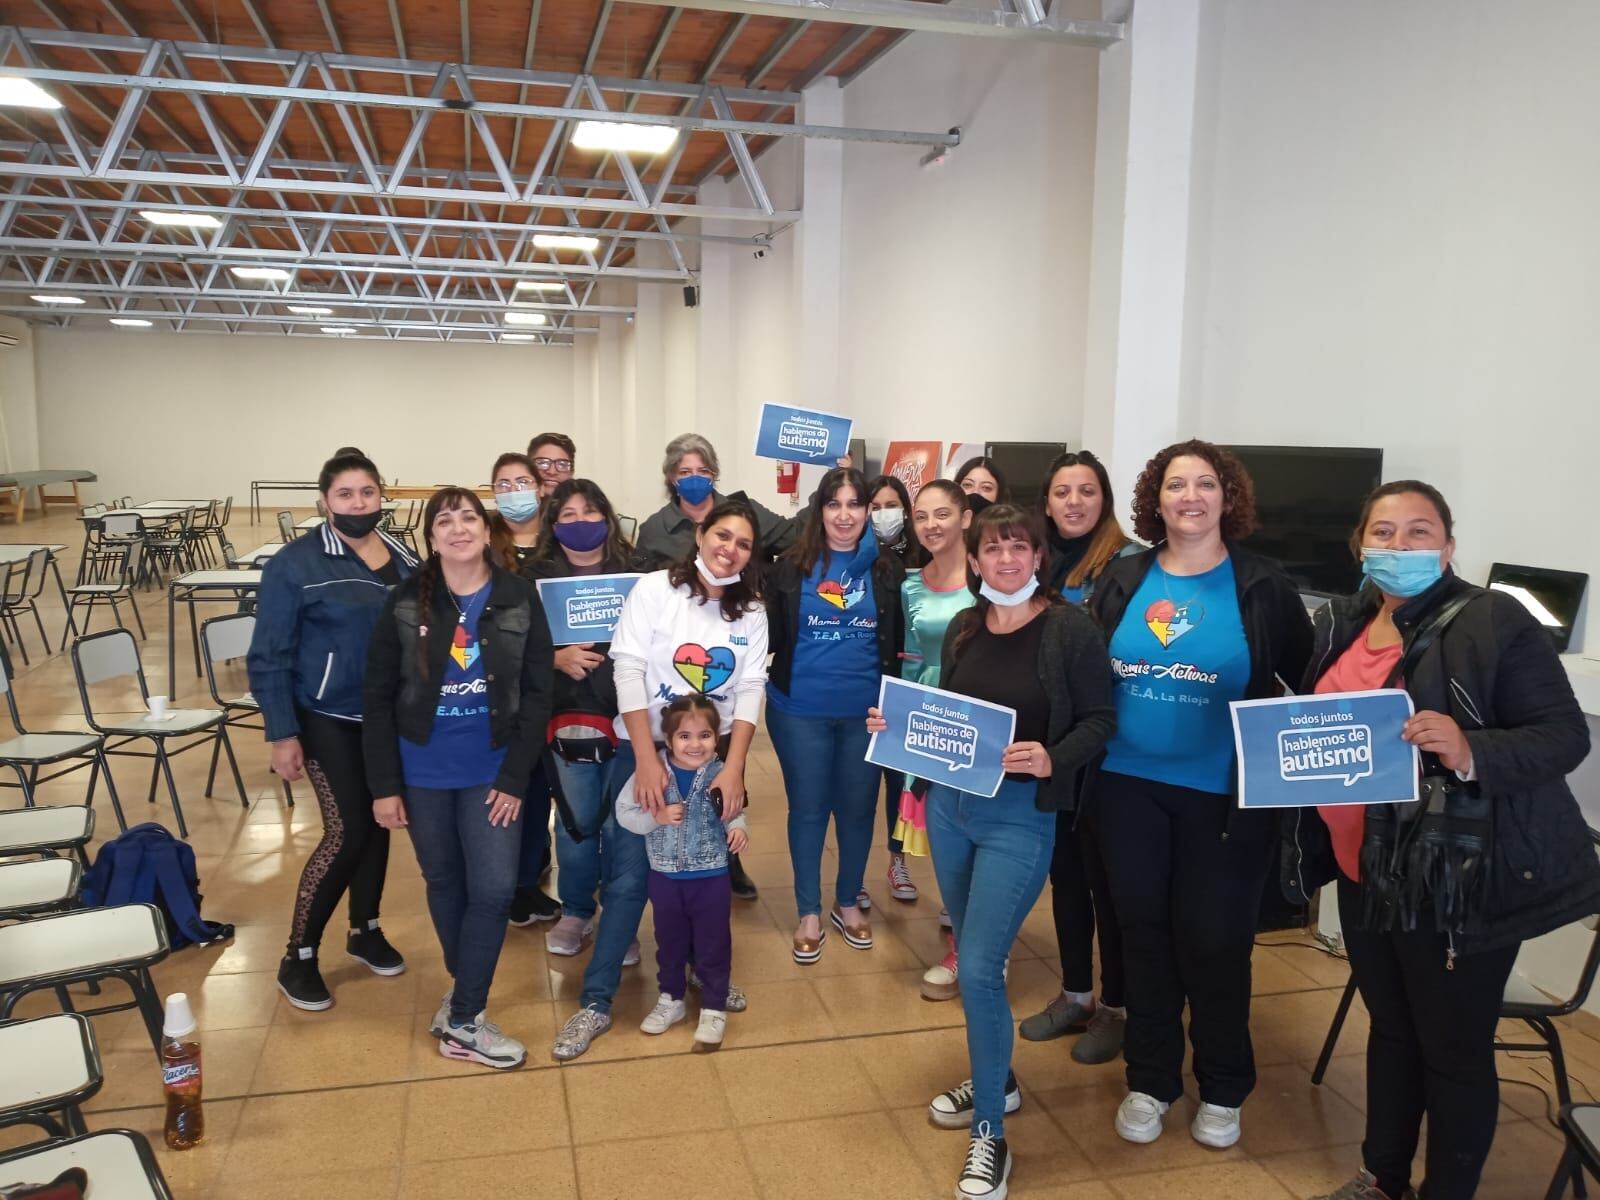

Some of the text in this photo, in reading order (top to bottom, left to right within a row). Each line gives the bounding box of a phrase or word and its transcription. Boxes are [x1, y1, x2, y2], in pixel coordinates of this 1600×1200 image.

[780, 434, 827, 448] autismo
[783, 427, 817, 437] hablemos
[575, 586, 615, 595] todos juntos
[570, 596, 622, 612] hablemos de
[568, 606, 624, 624] autismo
[807, 615, 840, 626] Mamis
[1111, 658, 1218, 684] Mamis Activas
[1121, 682, 1210, 707] T.E.A. La Rioja
[464, 707, 477, 715] La
[921, 702, 970, 721] todos juntos
[1289, 712, 1354, 726] todos juntos
[912, 718, 974, 740] hablemos de
[908, 731, 974, 757] autismo
[1284, 728, 1366, 753] hablemos de
[1282, 745, 1369, 773] autismo
